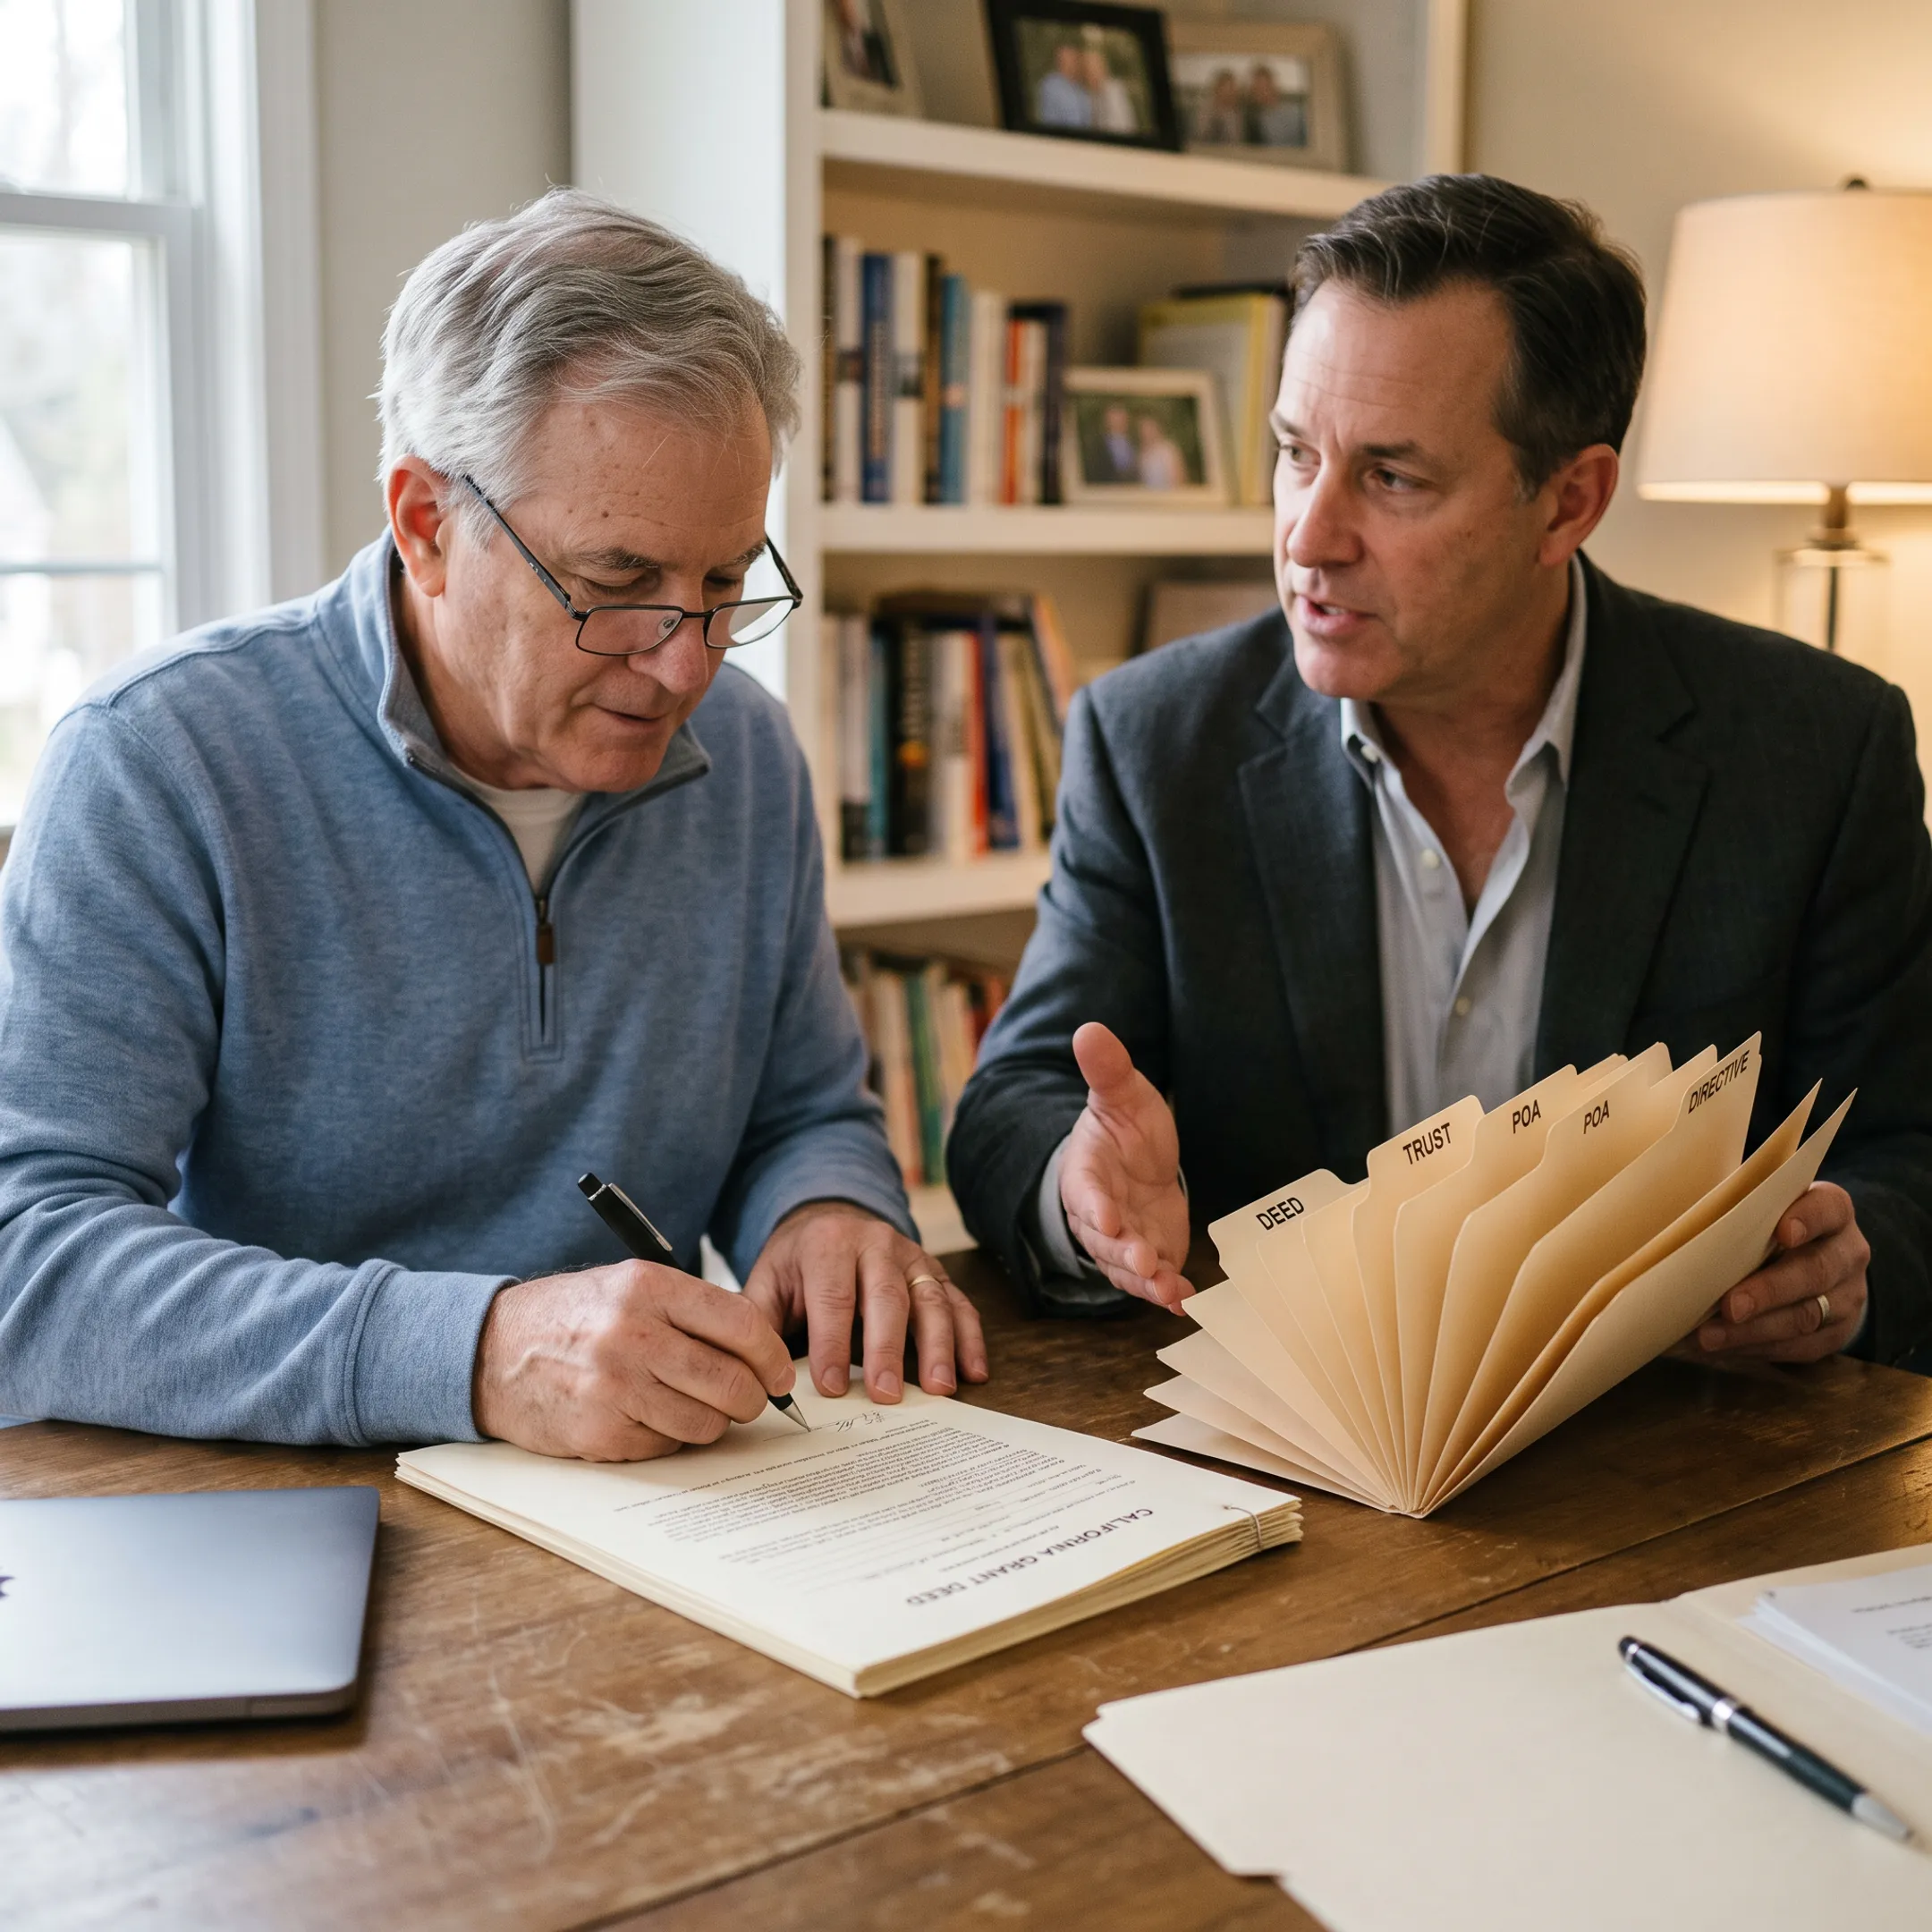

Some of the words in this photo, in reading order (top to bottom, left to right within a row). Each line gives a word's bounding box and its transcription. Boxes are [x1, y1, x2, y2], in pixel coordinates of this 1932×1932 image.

[1688, 1051, 1750, 1114] DIRECTIVE
[1513, 1099, 1541, 1133] POA
[1583, 1100, 1609, 1133] POA
[1402, 1123, 1451, 1165] TRUST
[1256, 1197, 1304, 1230] DEED
[1038, 1508, 1154, 1556] CALIFORNIA
[970, 1555, 1038, 1586] GRANT
[905, 1580, 968, 1607] DEED
